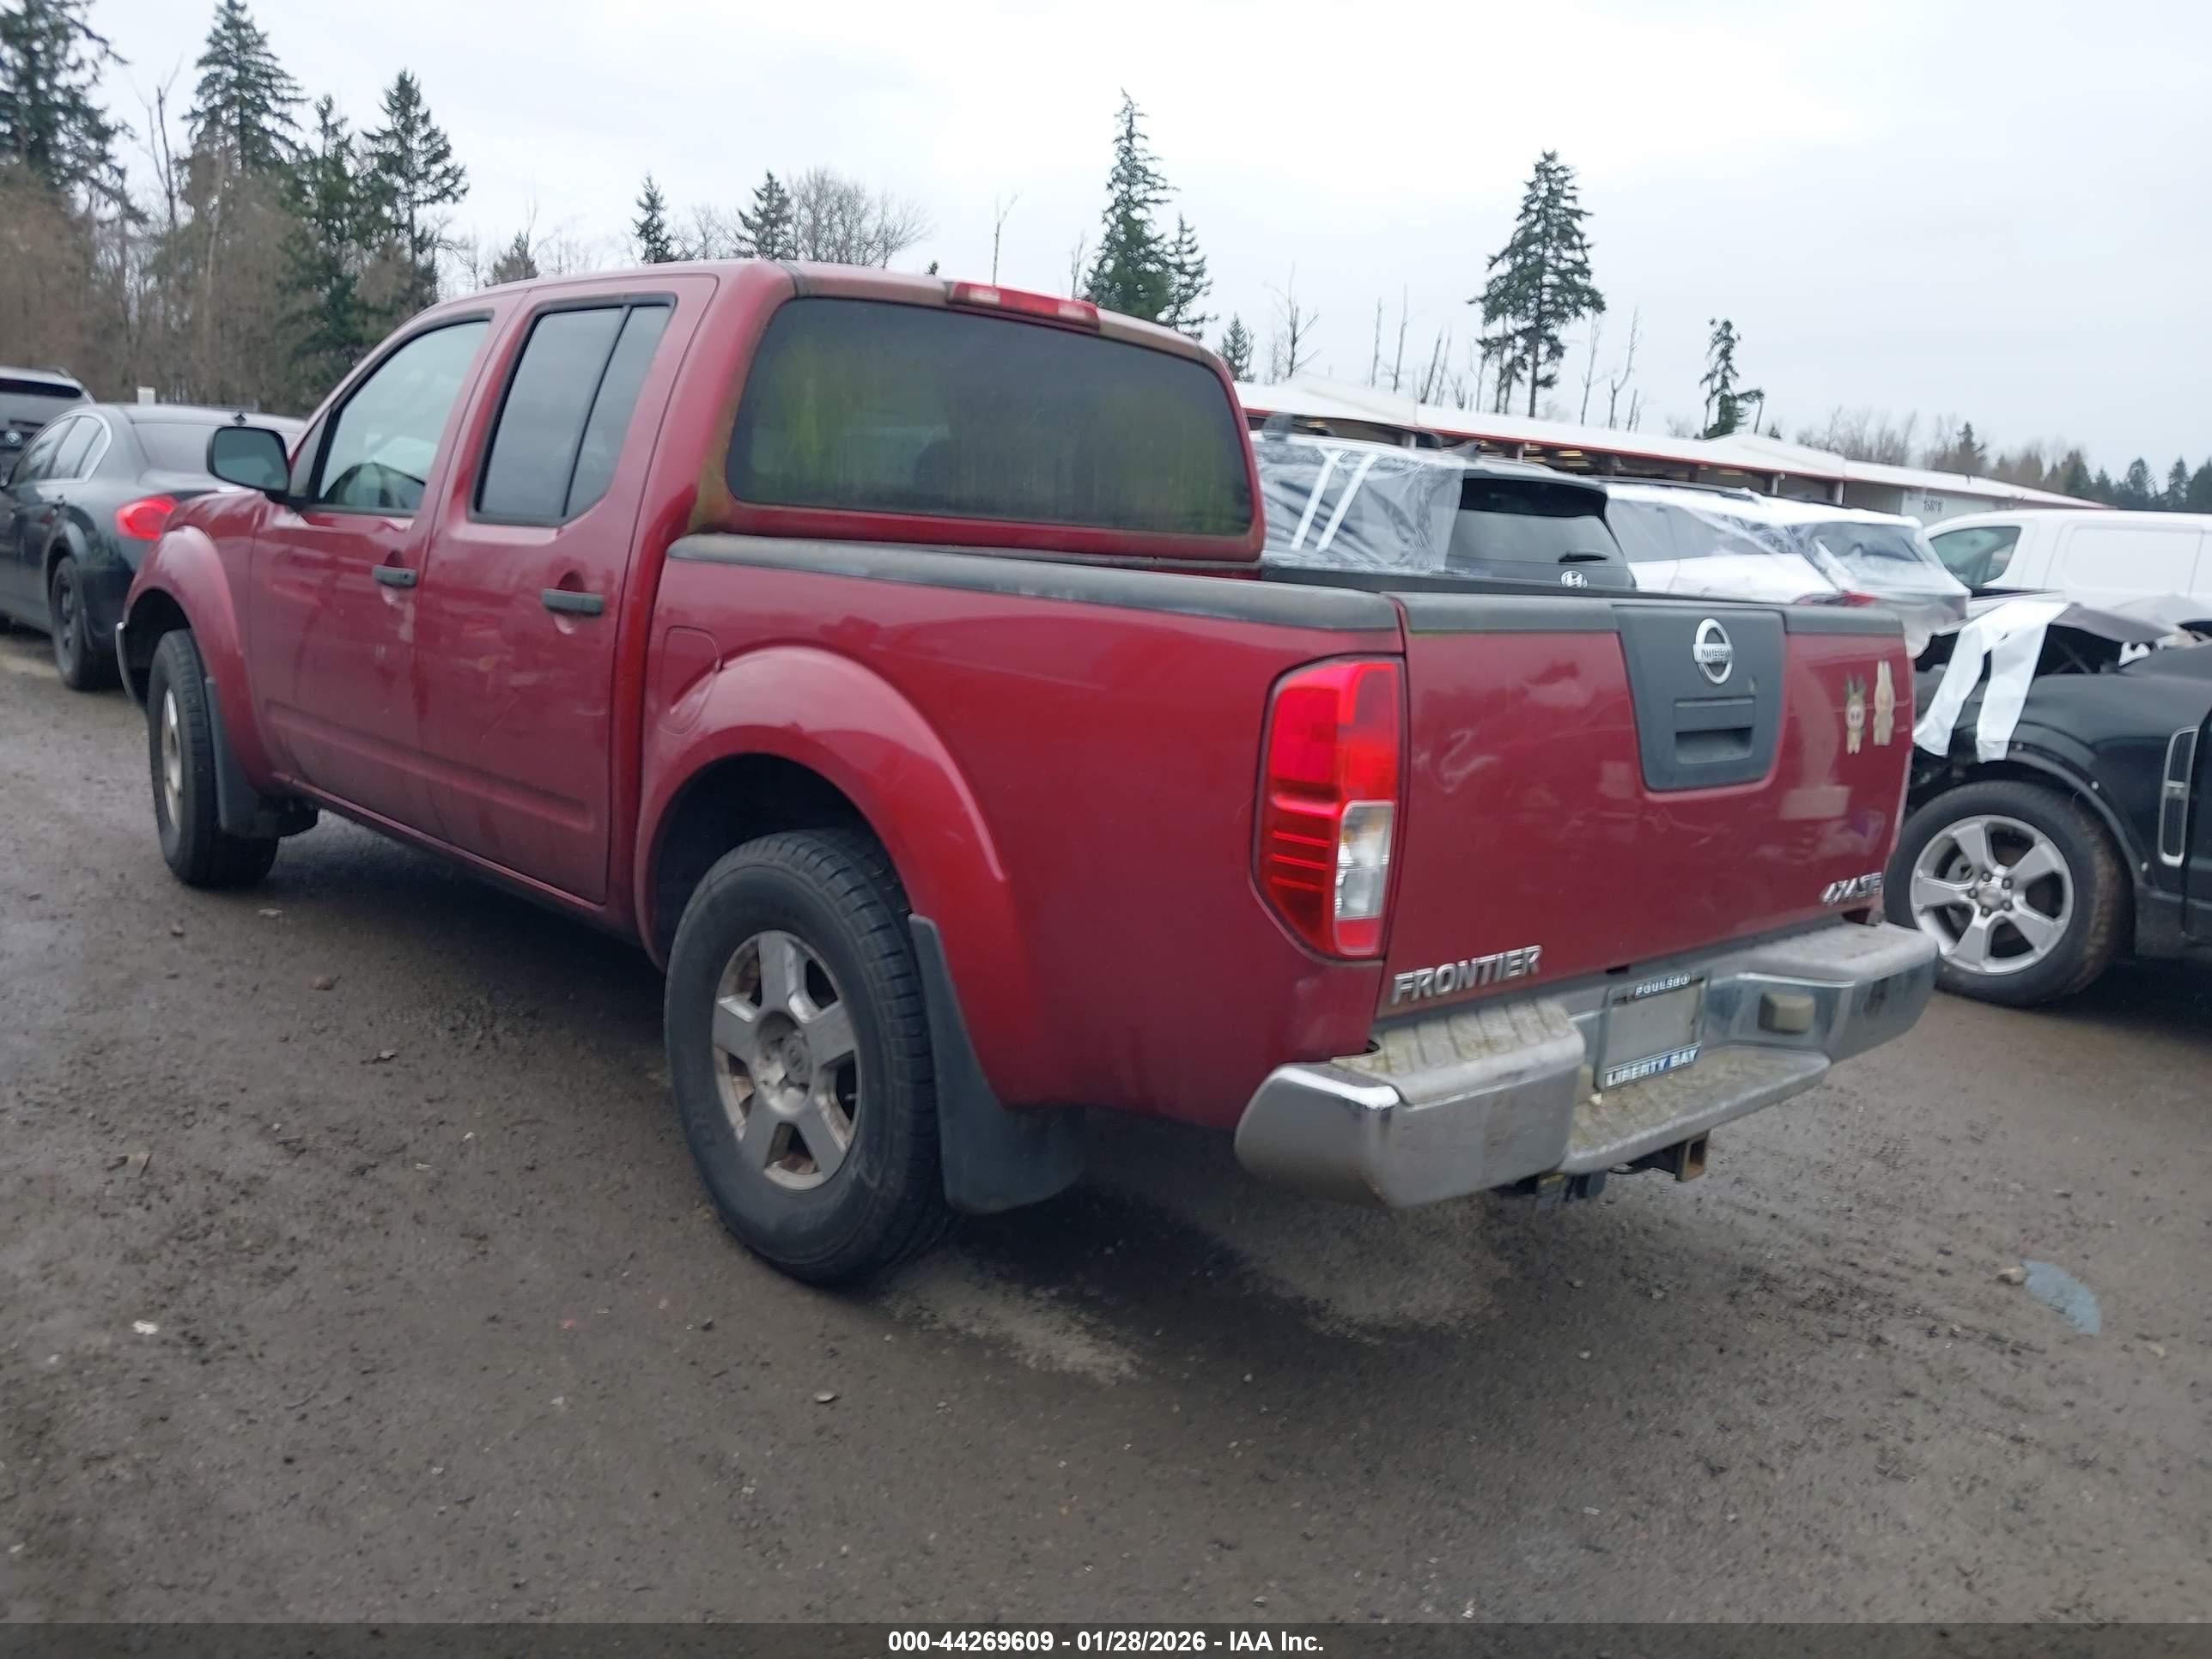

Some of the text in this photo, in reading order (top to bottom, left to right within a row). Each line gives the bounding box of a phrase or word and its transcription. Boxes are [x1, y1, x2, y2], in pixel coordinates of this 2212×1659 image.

[1389, 945, 1542, 1006] FRONTIER
[1606, 1048, 1698, 1087] LIBERTY BAY
